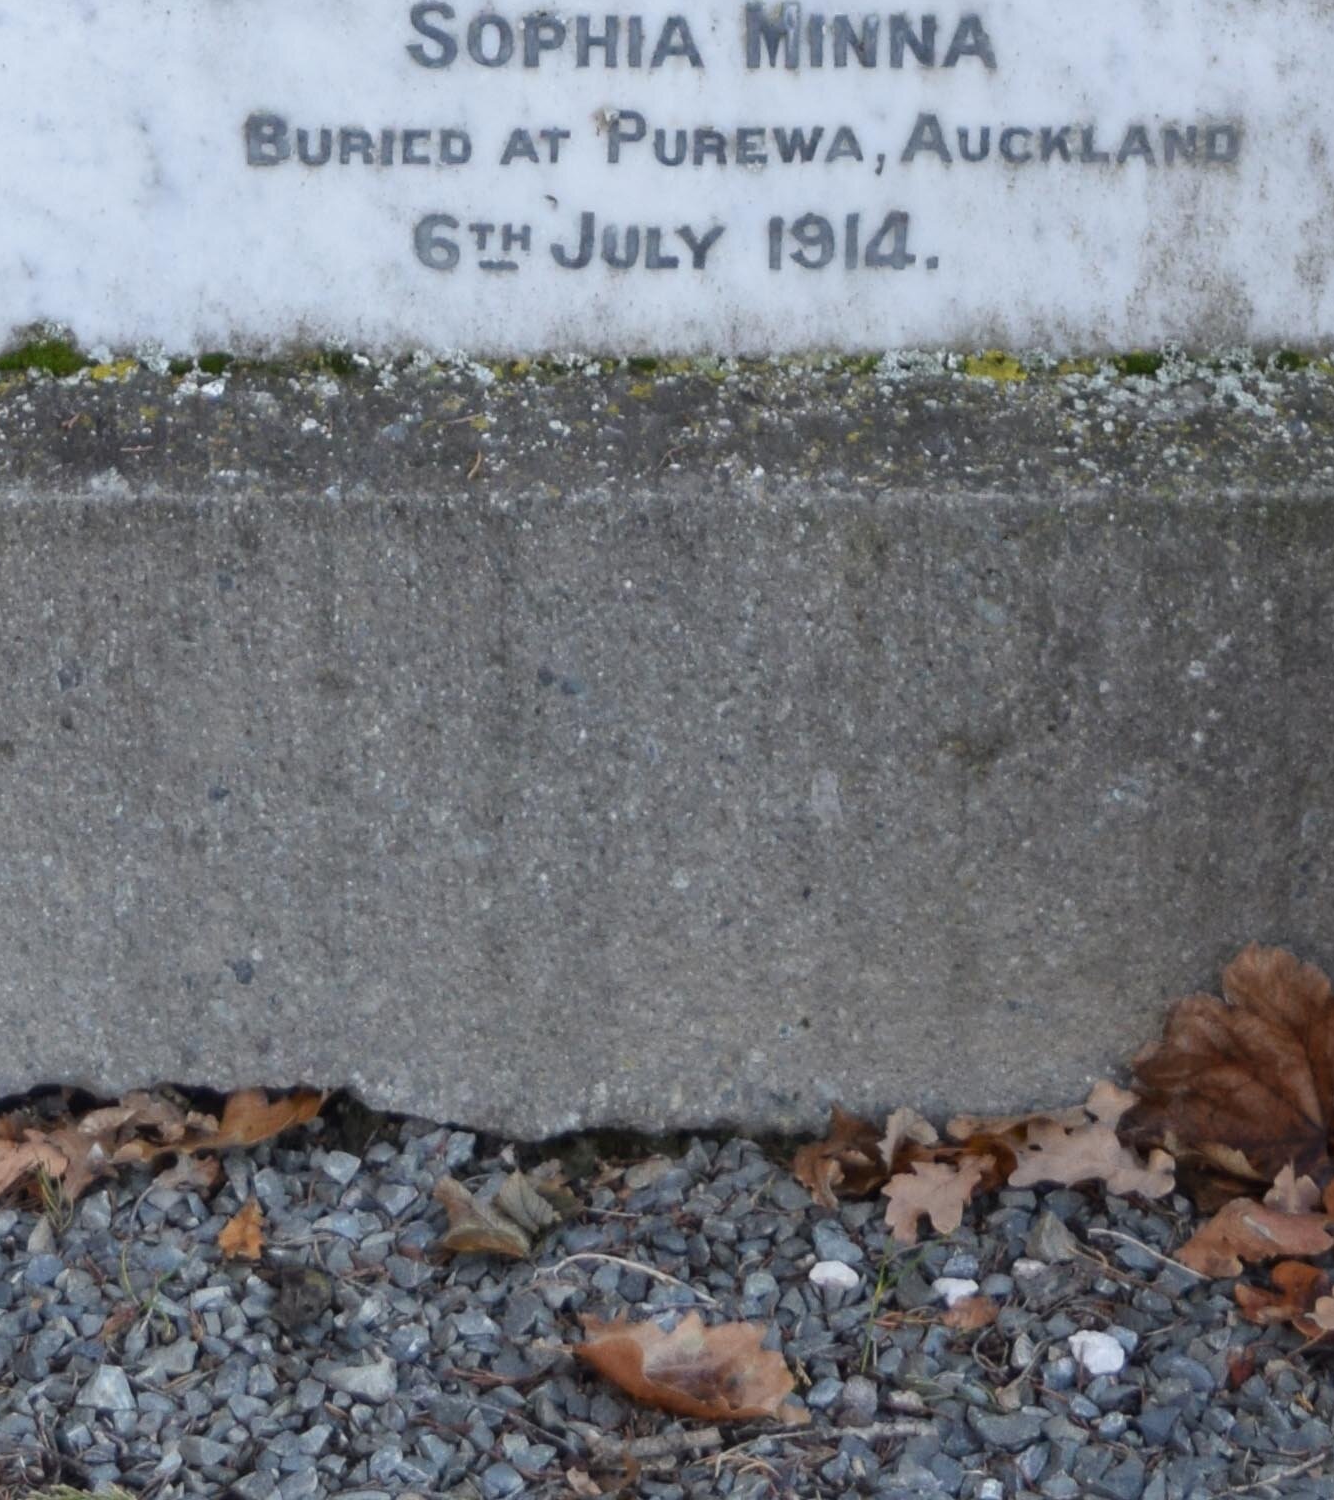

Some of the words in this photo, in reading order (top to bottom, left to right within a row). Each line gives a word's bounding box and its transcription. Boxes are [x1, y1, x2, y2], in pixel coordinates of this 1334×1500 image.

[407, 0, 703, 70] SOPHIA
[744, 2, 997, 72] MINNA
[245, 112, 473, 167] BURIED
[501, 129, 571, 166] AT
[606, 111, 887, 175] PUREWA,
[900, 114, 1241, 167] AUCKLAND
[412, 213, 531, 271] 6TH
[551, 212, 727, 271] JULY
[766, 213, 941, 271] 1914.
